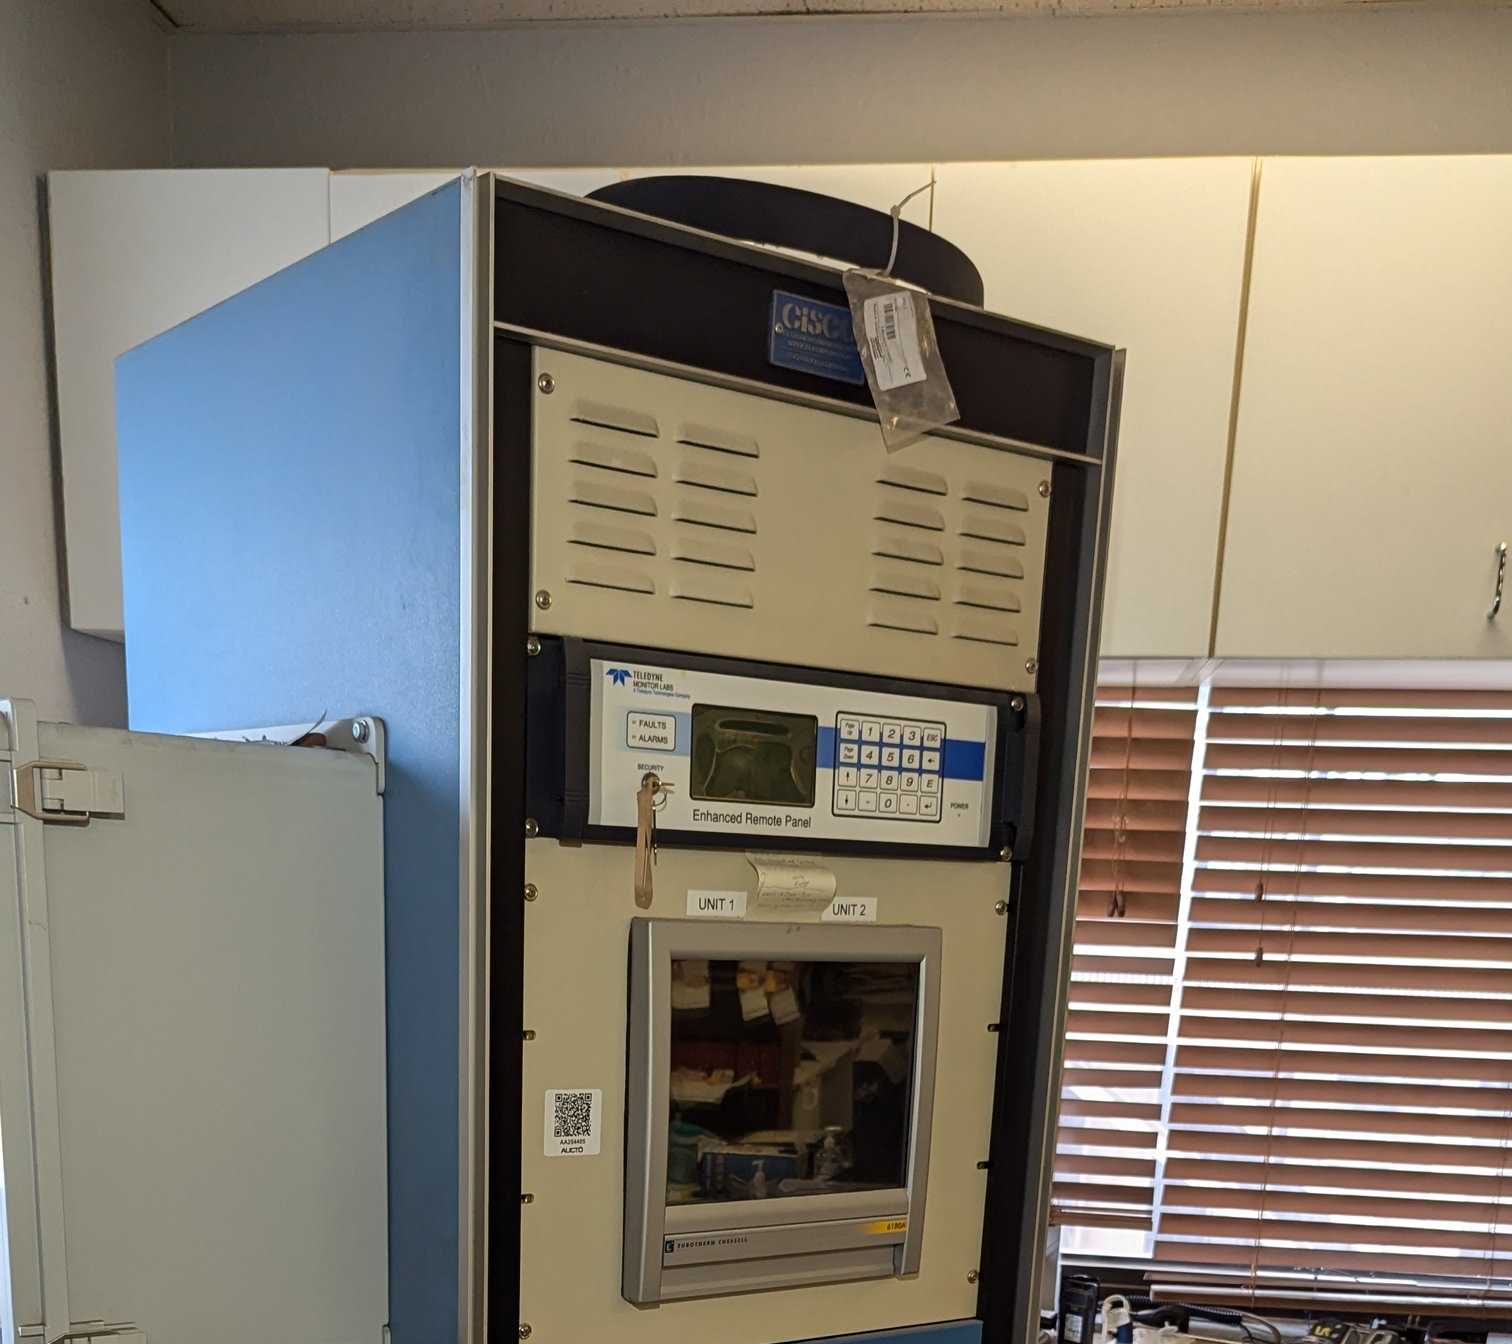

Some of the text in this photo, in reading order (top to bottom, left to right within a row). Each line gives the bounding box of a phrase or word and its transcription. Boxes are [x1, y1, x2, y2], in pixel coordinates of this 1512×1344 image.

[633, 670, 663, 682] TELEDYNE
[633, 680, 659, 690] MONITOR
[639, 719, 667, 730] FAULTS
[638, 735, 668, 745] ALARMS
[868, 727, 873, 736] 1
[888, 728, 896, 738] 2
[908, 731, 916, 741] 3
[865, 751, 915, 764] 4 5 6
[637, 762, 664, 771] SECURITY
[866, 773, 873, 783] 7
[886, 775, 894, 785] 8
[906, 777, 914, 787] 9
[885, 799, 892, 808] 0
[692, 808, 812, 829] Enhanced Remote Panel
[698, 897, 735, 911] UNIT 1
[832, 903, 867, 916] UNIT 2
